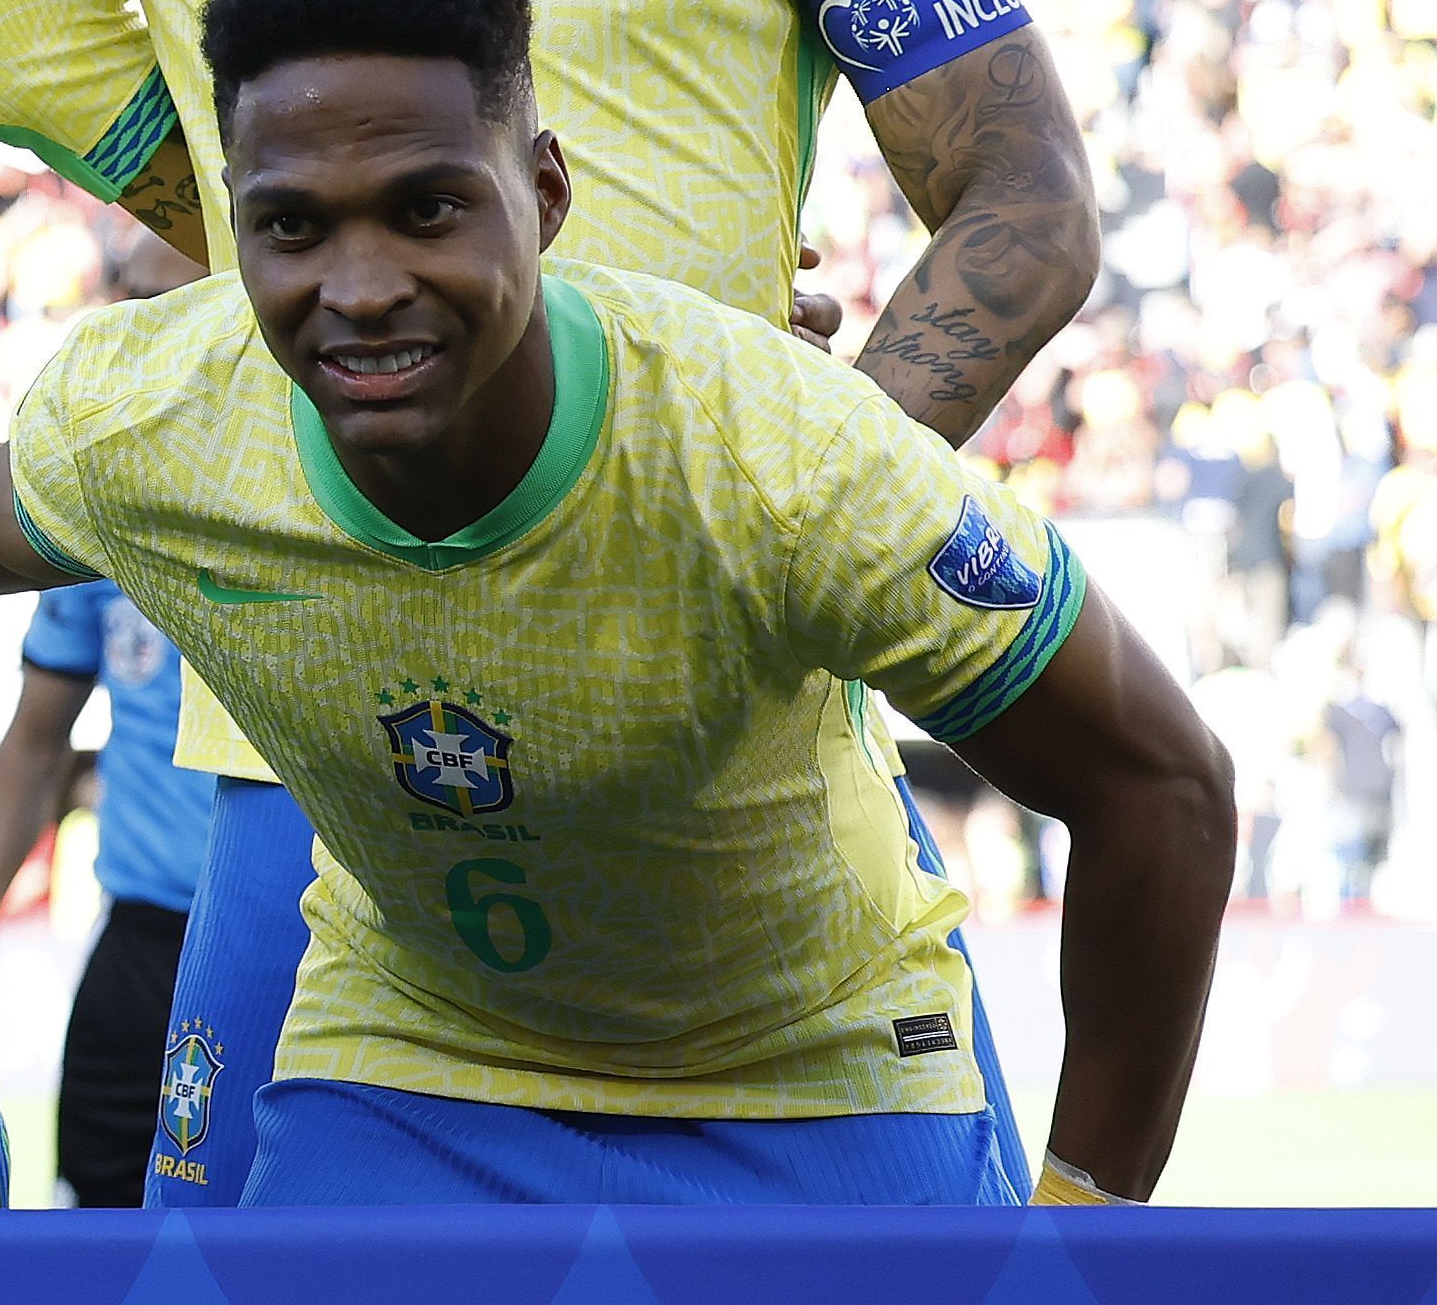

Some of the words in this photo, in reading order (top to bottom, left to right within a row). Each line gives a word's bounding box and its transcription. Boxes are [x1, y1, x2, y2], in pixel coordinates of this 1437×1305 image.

[956, 526, 1002, 586] VIBR
[424, 747, 474, 771] CBF
[409, 810, 542, 842] BRASIL
[445, 857, 553, 974] 6
[175, 1082, 196, 1099] CBF
[154, 1152, 210, 1186] BRASIL
